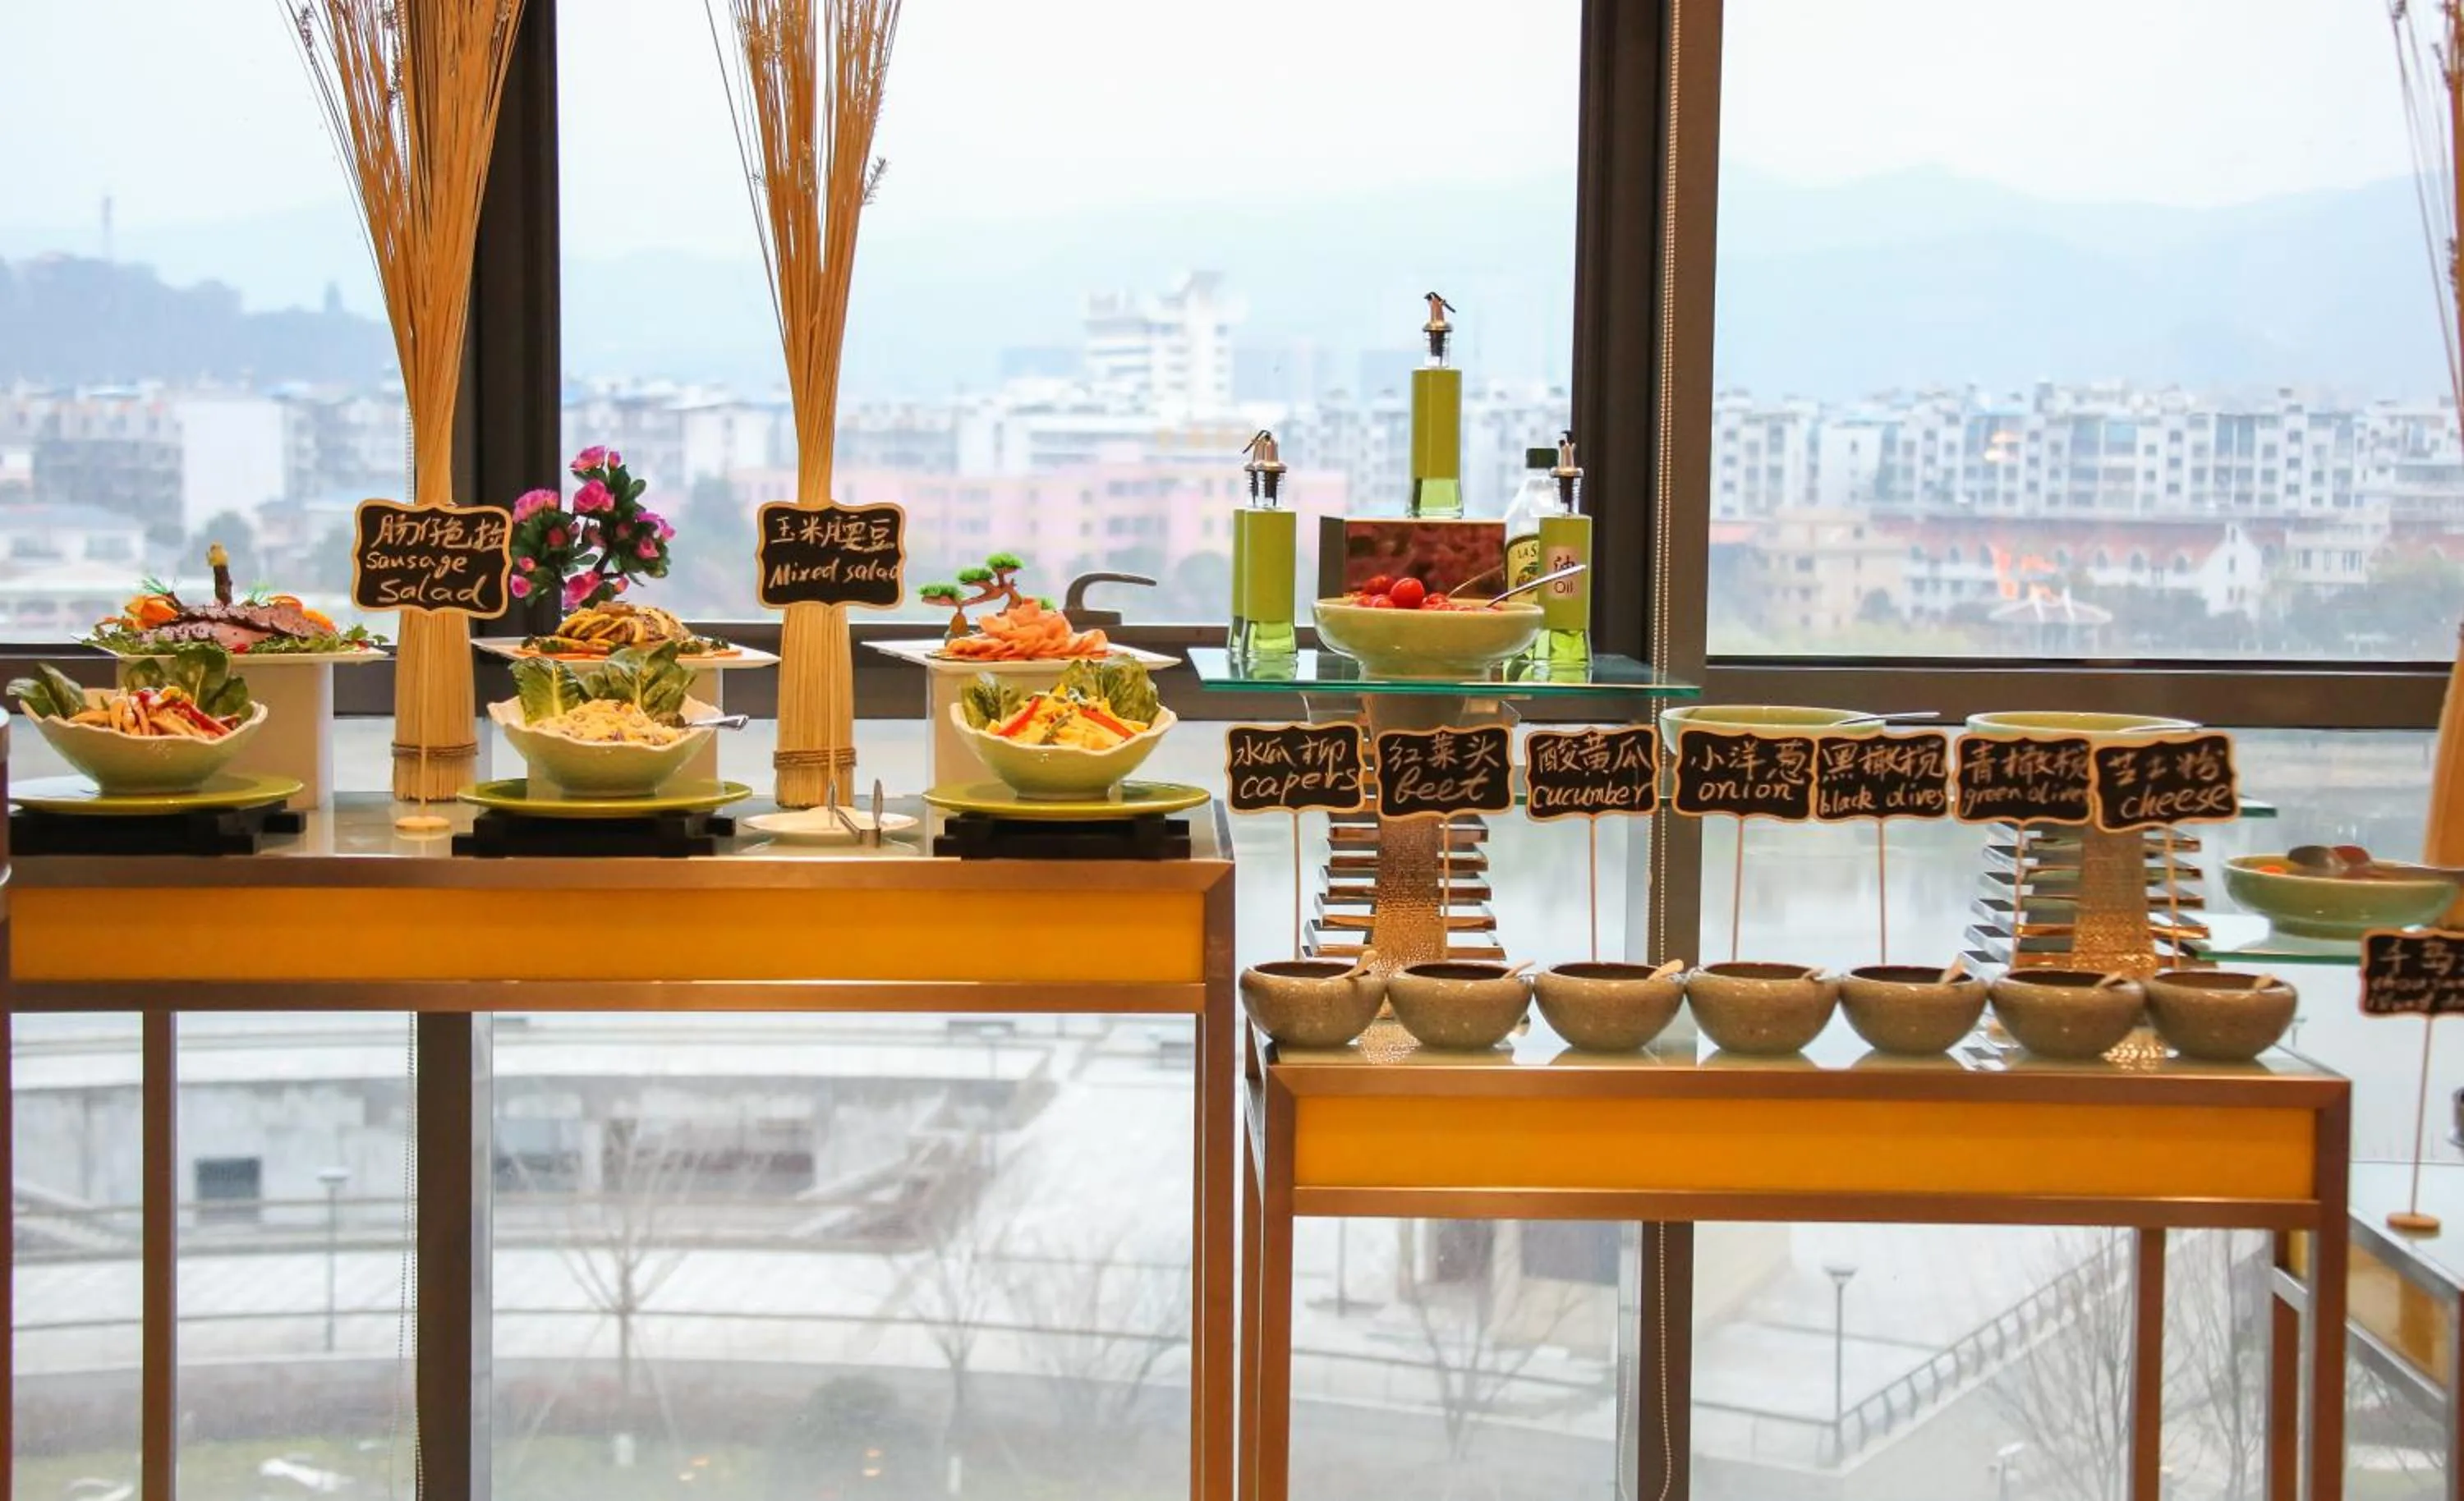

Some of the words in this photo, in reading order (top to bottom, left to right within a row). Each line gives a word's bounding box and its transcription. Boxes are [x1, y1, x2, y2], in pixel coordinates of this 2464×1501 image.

[768, 557, 841, 590] Mixed
[1554, 581, 1574, 594] Oil
[1537, 735, 1653, 776] 酸黄瓜
[1690, 739, 1806, 784] 小洋葱
[1239, 768, 1358, 805] capers
[1698, 780, 1795, 801] onion
